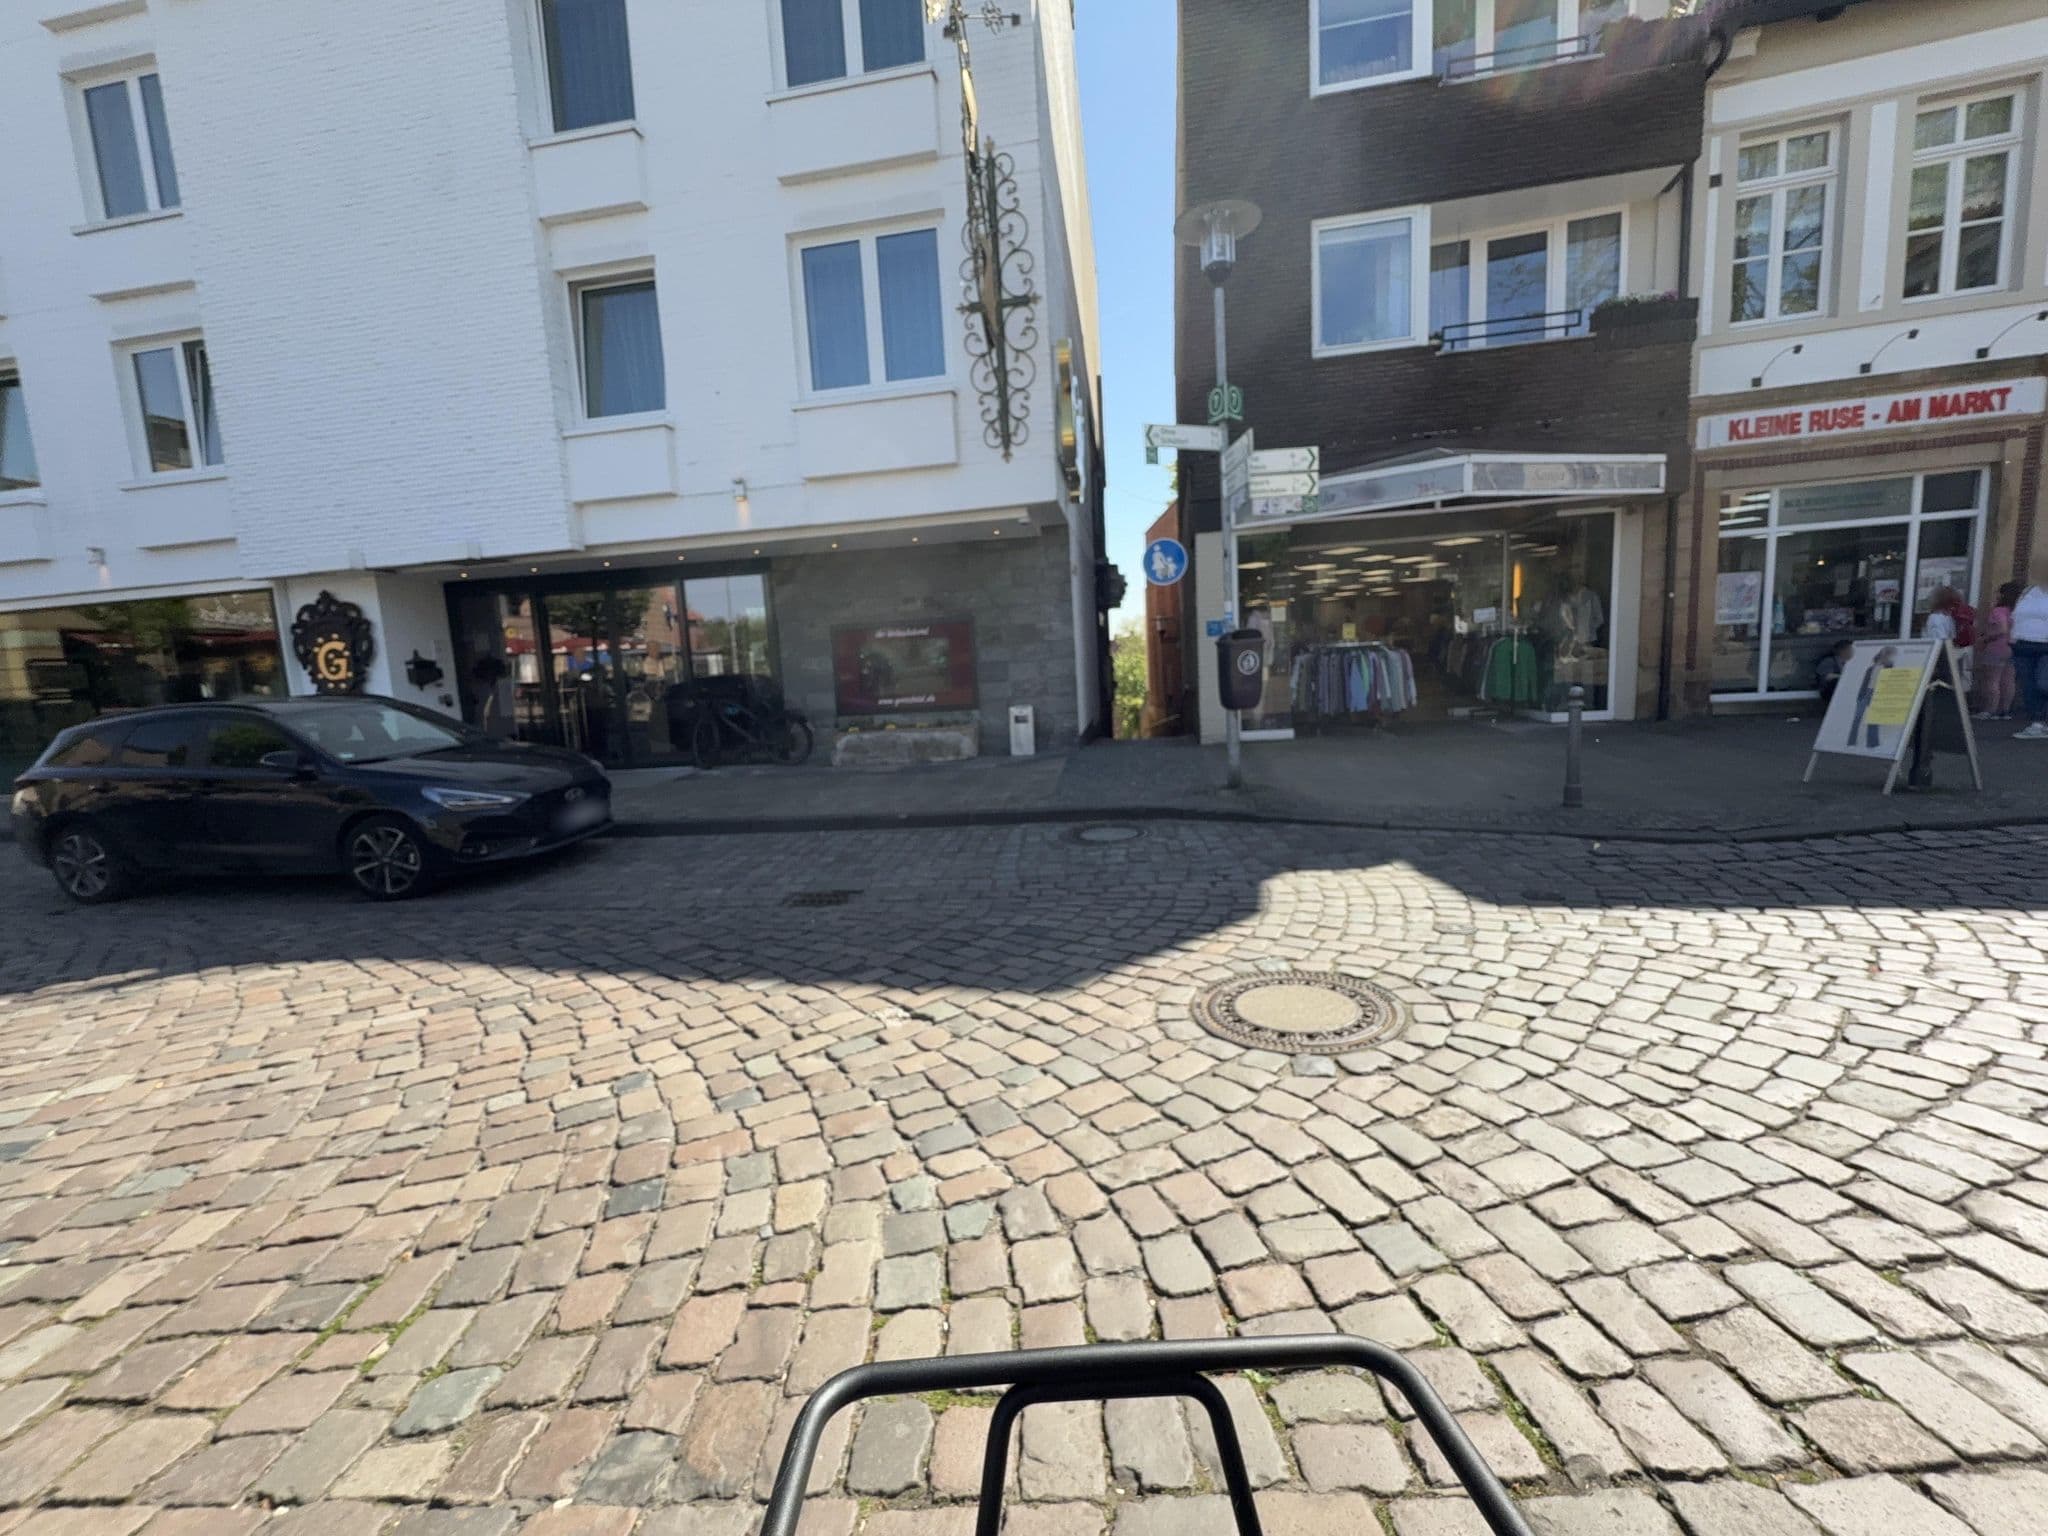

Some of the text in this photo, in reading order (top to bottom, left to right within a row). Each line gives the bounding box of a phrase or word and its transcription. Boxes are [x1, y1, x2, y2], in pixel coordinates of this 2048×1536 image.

[1728, 412, 1803, 440] KLEINE
[1808, 404, 1866, 432] RUSE
[1887, 398, 1922, 424] AM
[1928, 387, 2012, 419] MARKT
[318, 641, 348, 680] G
